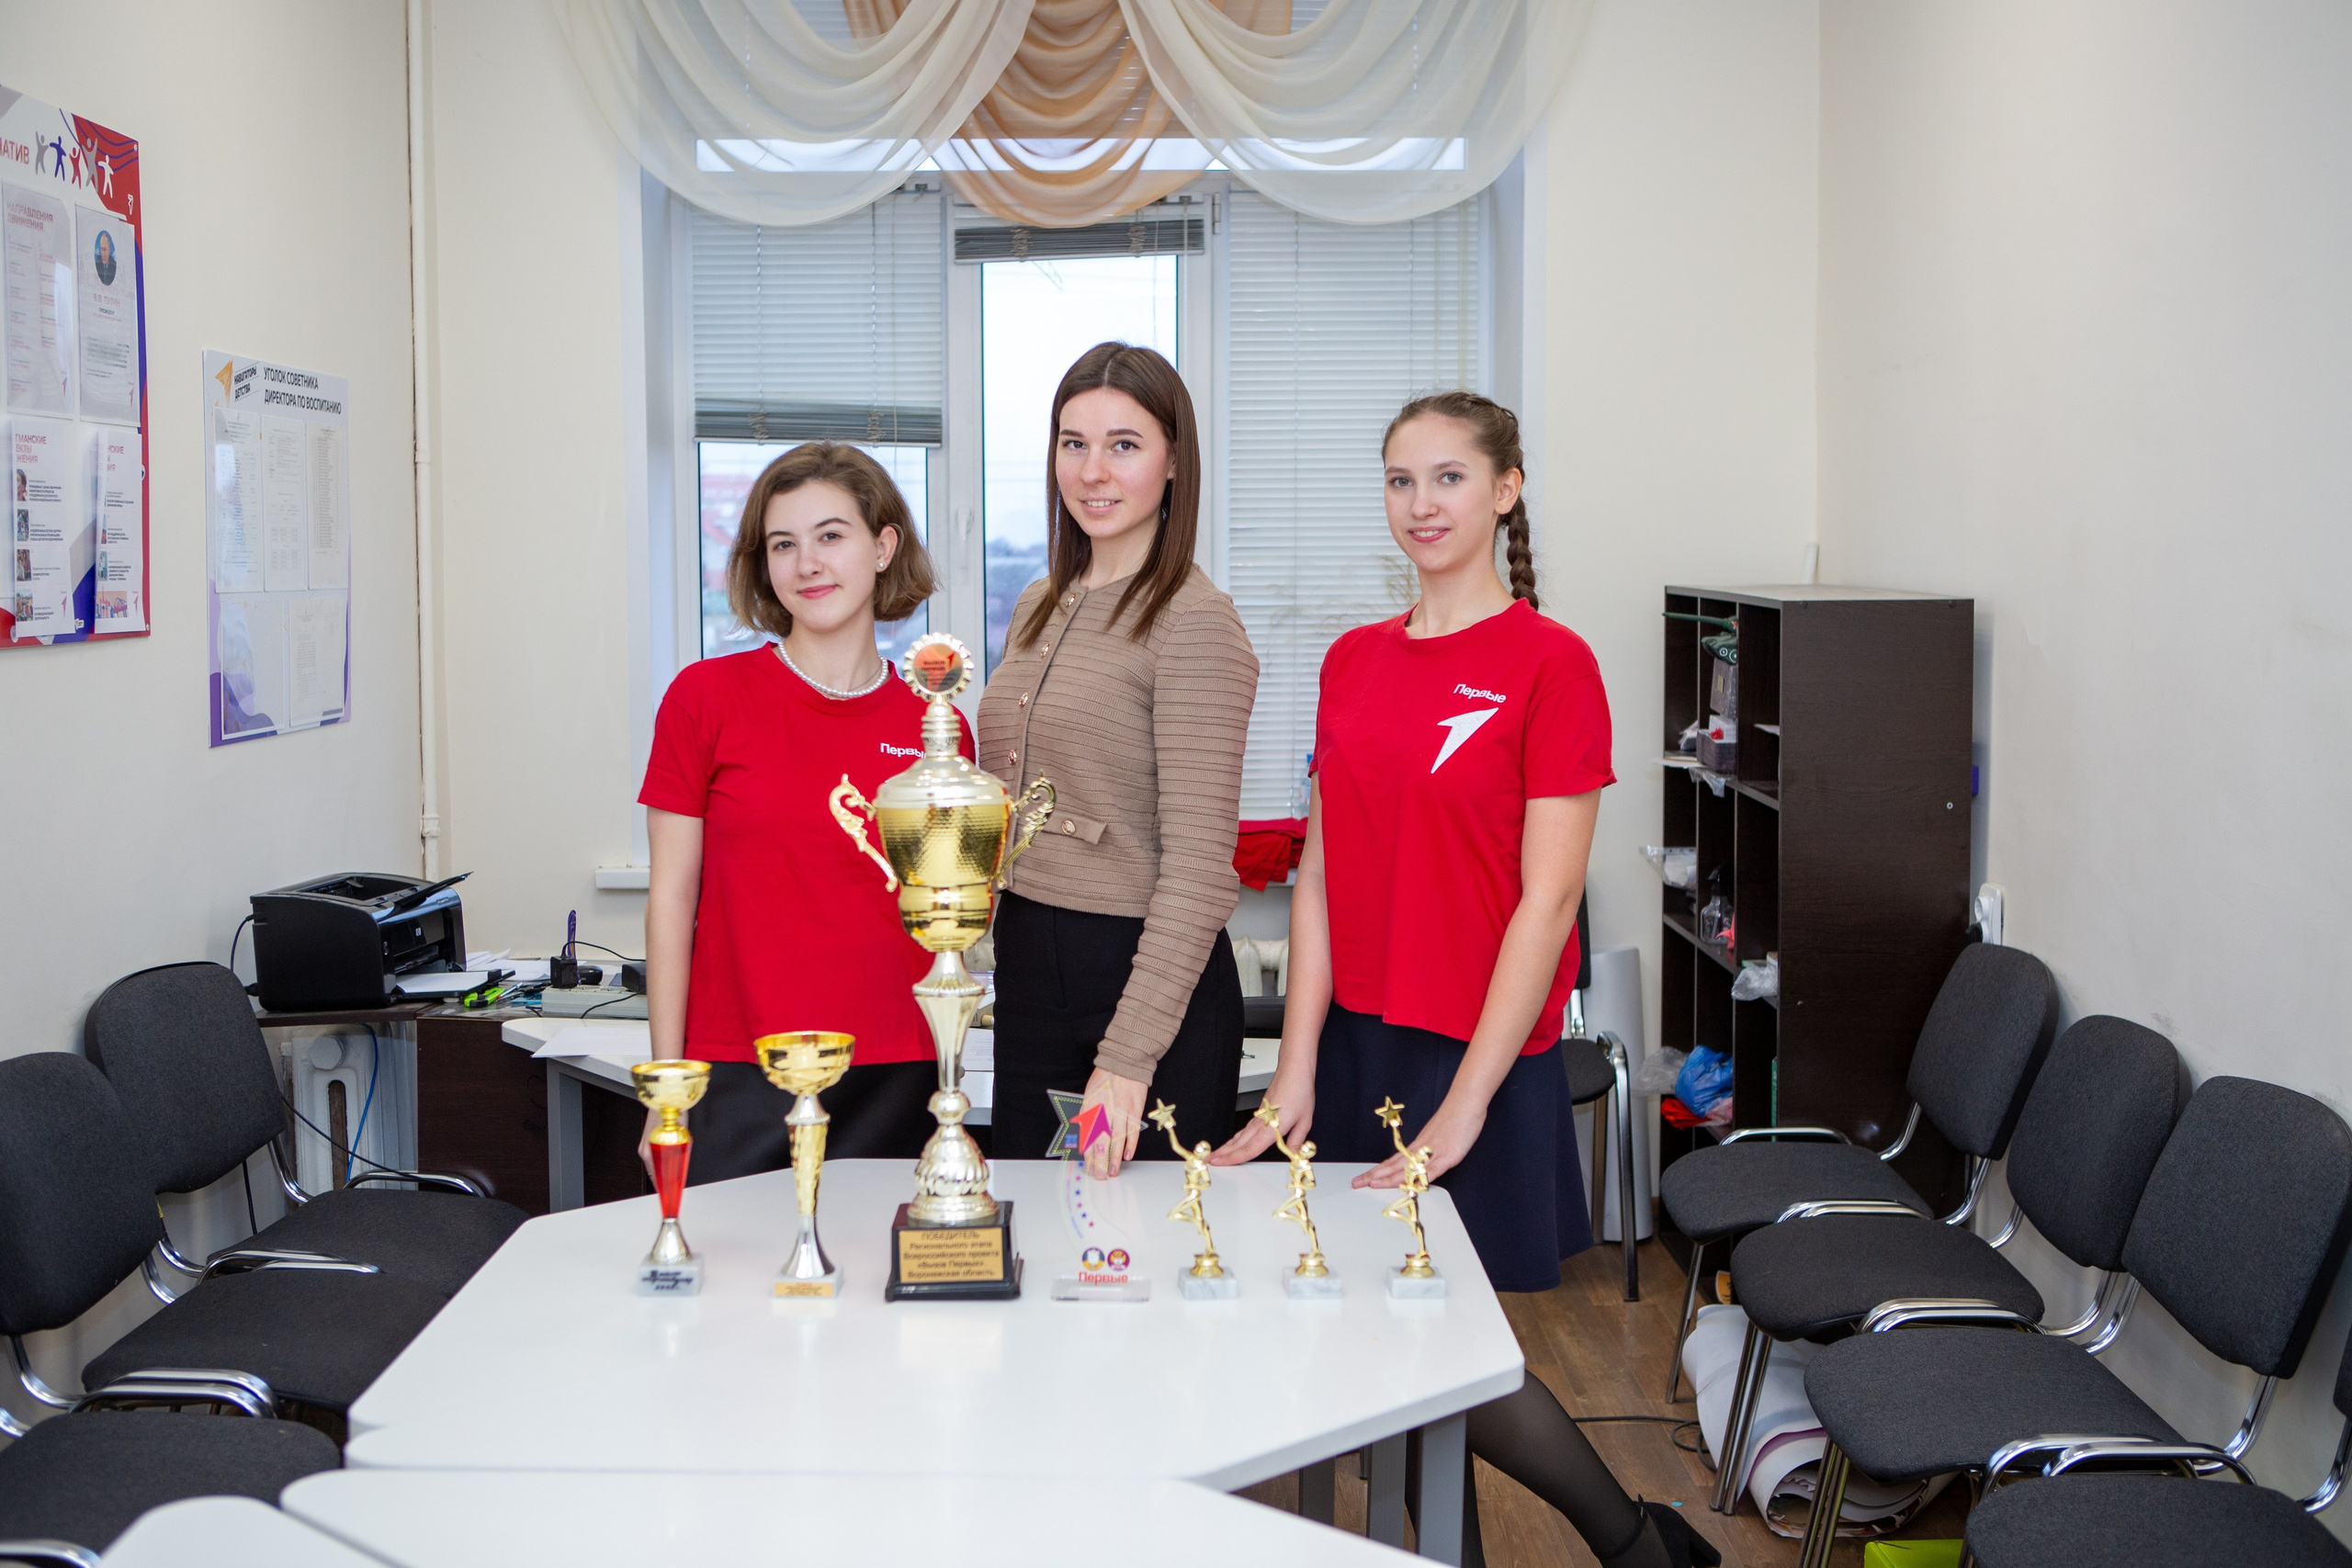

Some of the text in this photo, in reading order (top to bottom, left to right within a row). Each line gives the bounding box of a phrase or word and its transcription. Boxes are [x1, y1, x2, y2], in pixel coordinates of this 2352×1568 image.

[6, 201, 53, 223] НАПРАВЛЕНИЯ
[7, 212, 44, 231] ДВИЖЕНИЯ
[103, 295, 120, 307] ПУТИН
[234, 366, 257, 385] НАВИГАТОРЫ
[264, 367, 319, 389] УГОЛОК СОВЕТНИКА
[234, 382, 251, 400] ДЕТСТВА
[265, 389, 342, 414] ДИРЕКТОРА ПО ВОСПИТАНИЮ
[1453, 683, 1507, 703] Первые
[921, 1230, 980, 1240] ПОБЕДИТЕЛЬ
[1079, 1271, 1128, 1286] Первые
